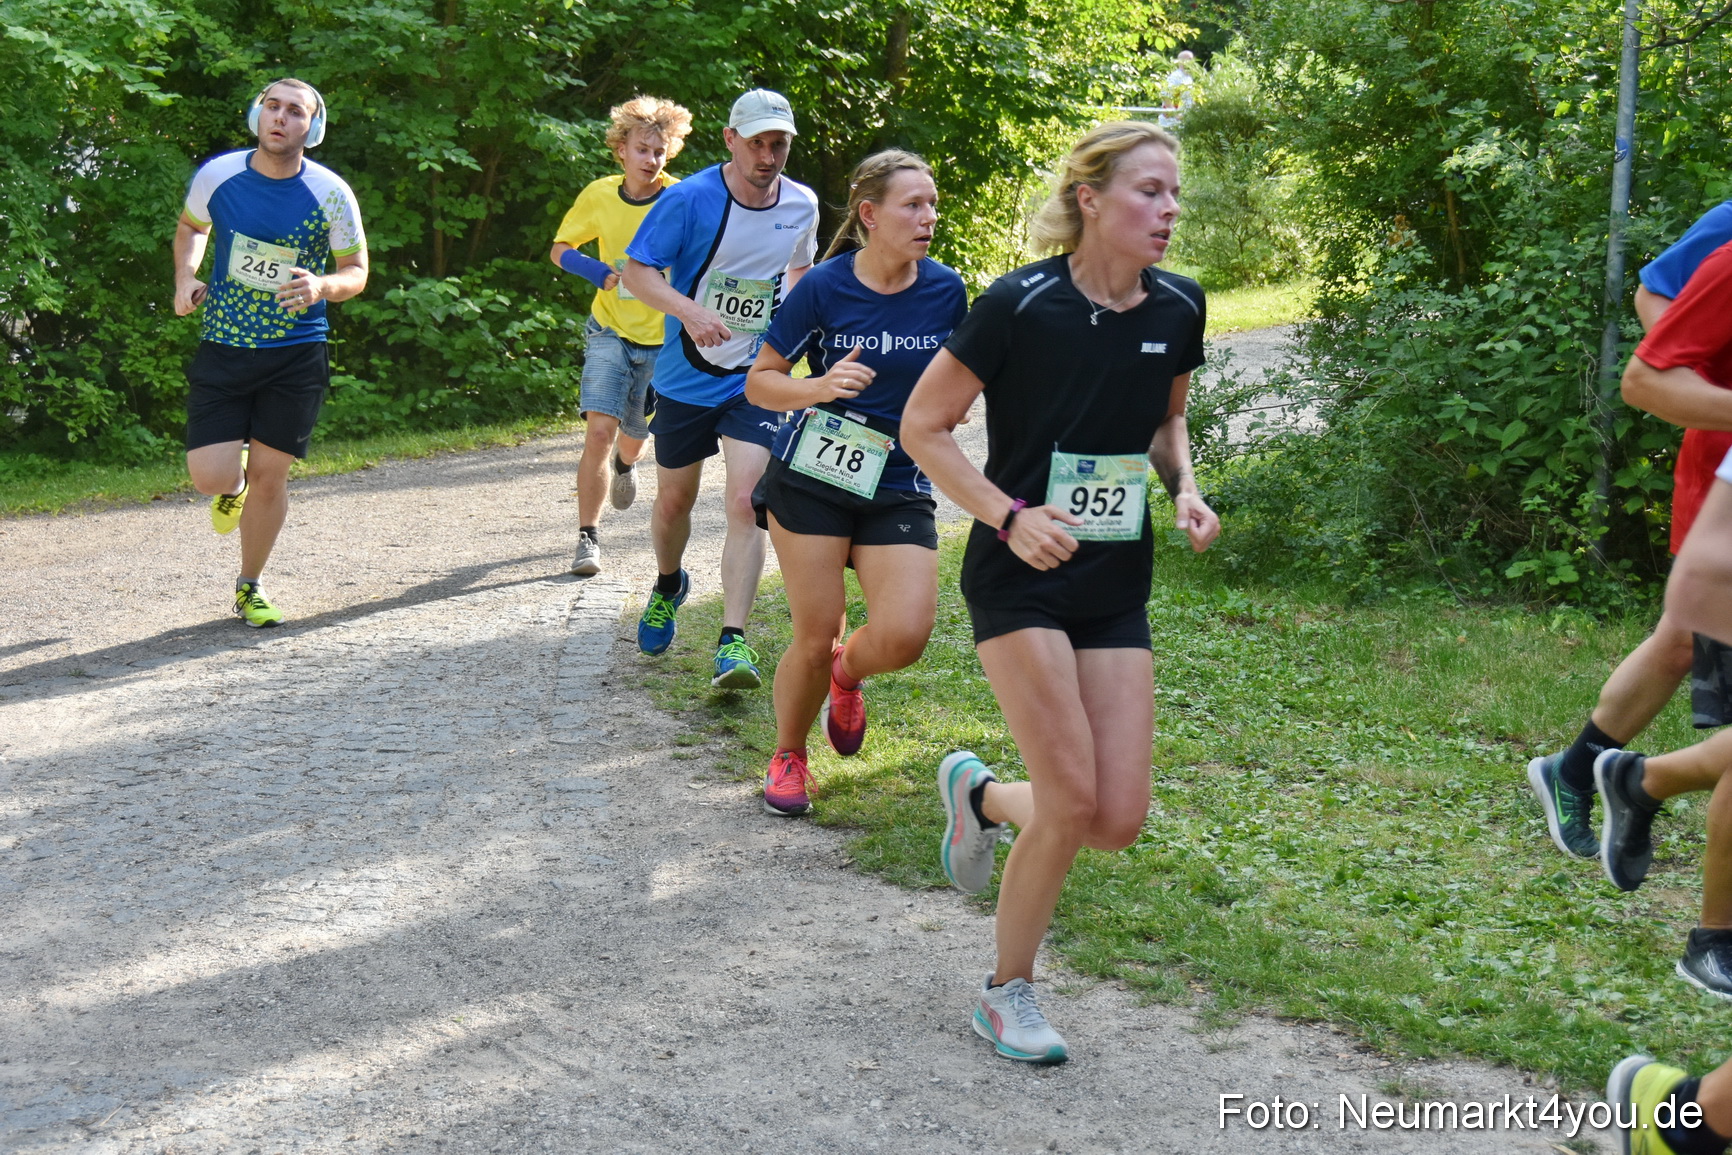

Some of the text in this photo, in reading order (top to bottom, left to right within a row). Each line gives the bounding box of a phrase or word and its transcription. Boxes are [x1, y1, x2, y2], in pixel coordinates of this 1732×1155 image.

[241, 255, 280, 279] 245
[714, 292, 765, 319] 1062
[736, 316, 754, 324] Stefan
[834, 334, 939, 350] EURO POLES
[816, 436, 865, 473] 718
[815, 461, 854, 480] Ziegler Nina
[1069, 487, 1126, 517] 952
